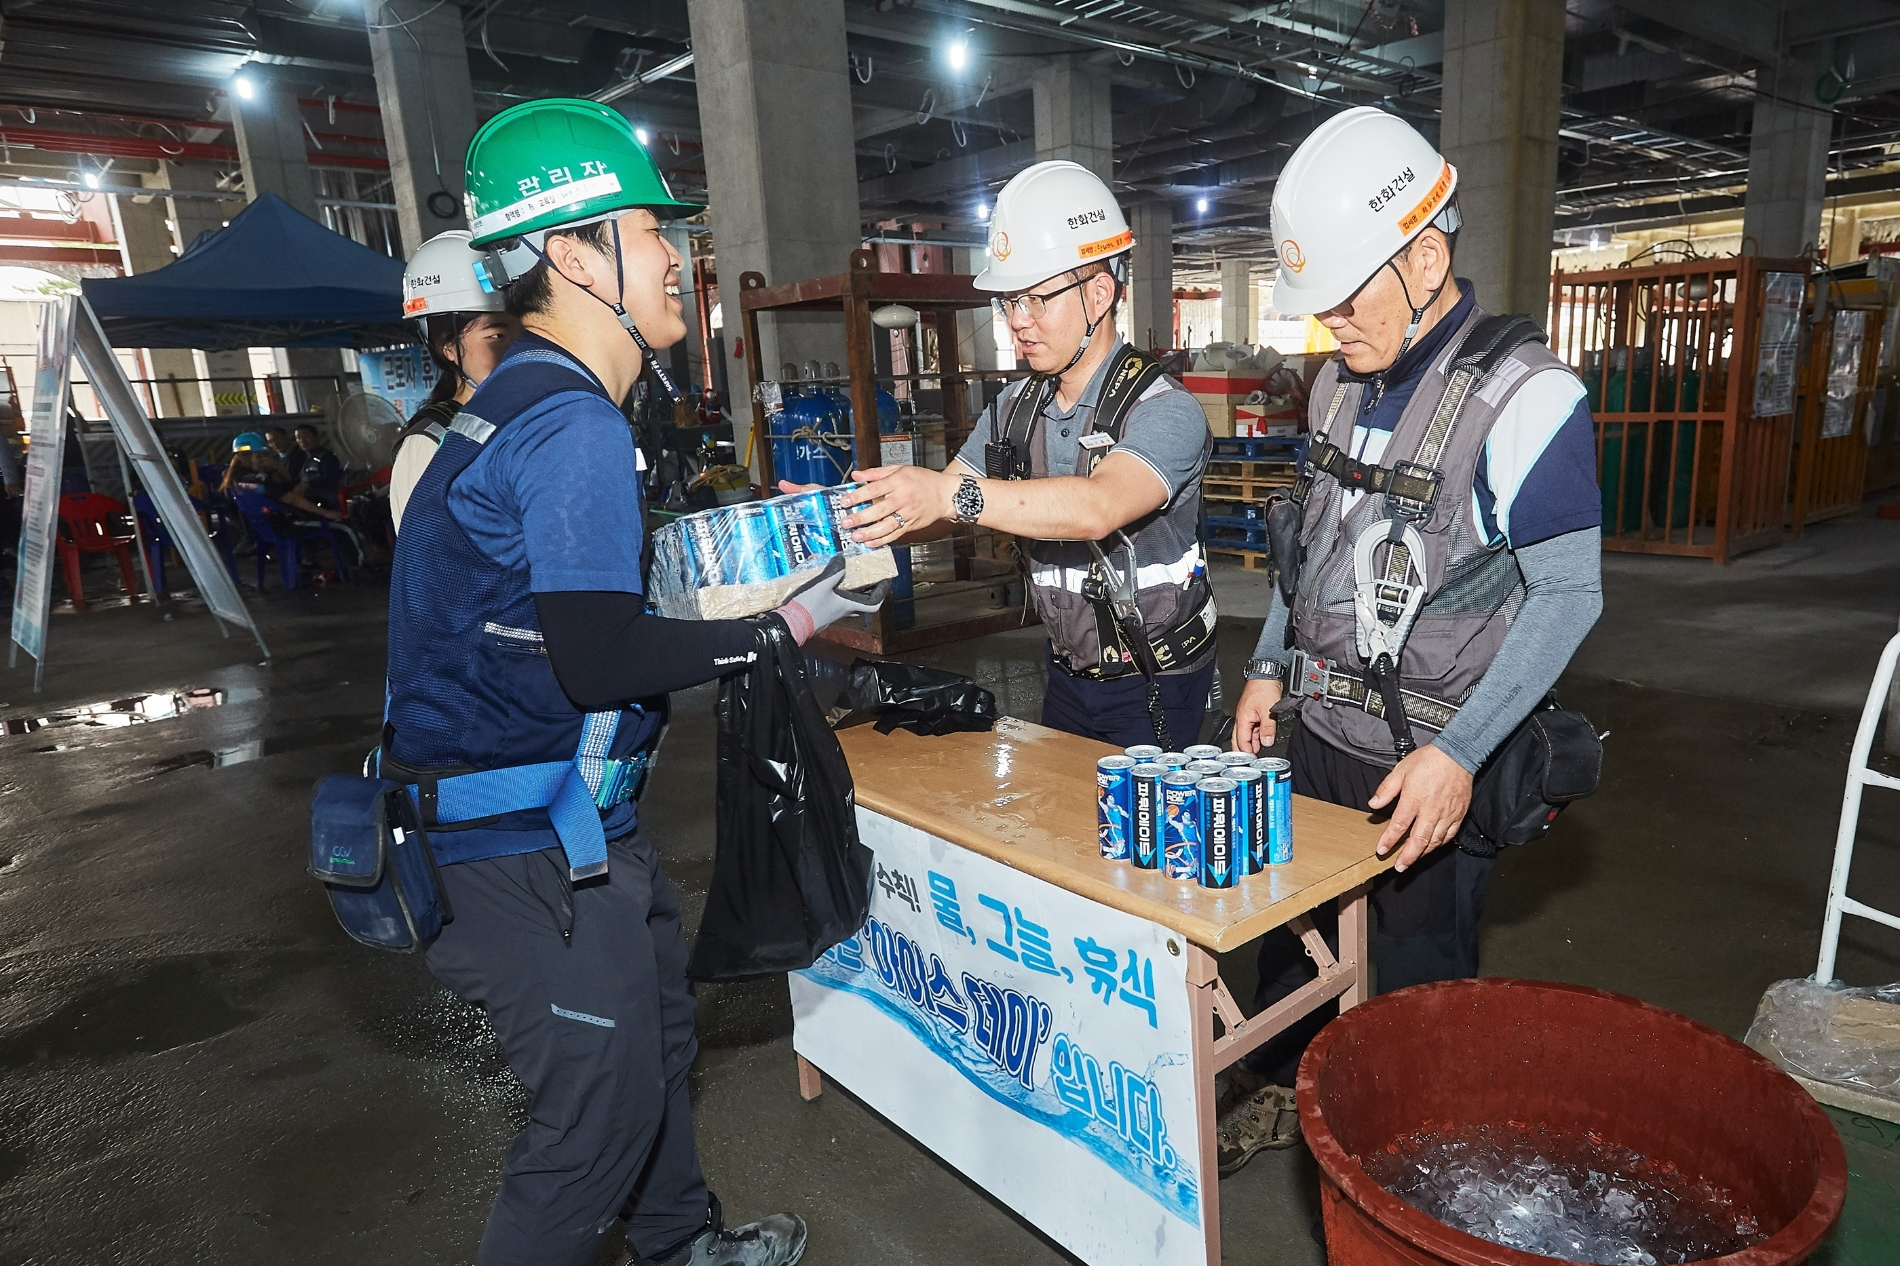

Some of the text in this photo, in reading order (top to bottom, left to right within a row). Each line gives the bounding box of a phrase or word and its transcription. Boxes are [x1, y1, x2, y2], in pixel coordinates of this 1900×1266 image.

[517, 160, 607, 197] 관리자
[1368, 166, 1416, 213] 한화건설
[1066, 208, 1106, 230] 한화건설
[410, 274, 441, 289] 한화건설
[384, 352, 416, 391] 근로자
[656, 367, 673, 392] SAFETY
[1109, 368, 1129, 398] NEPA
[1166, 789, 1196, 799] POWER
[1138, 782, 1150, 857] 파워에이드
[1213, 797, 1225, 875] 파워에이드
[876, 862, 1158, 1029] 수칙! 물, 그늘, 휴식
[1051, 1032, 1178, 1171] 입니다.
